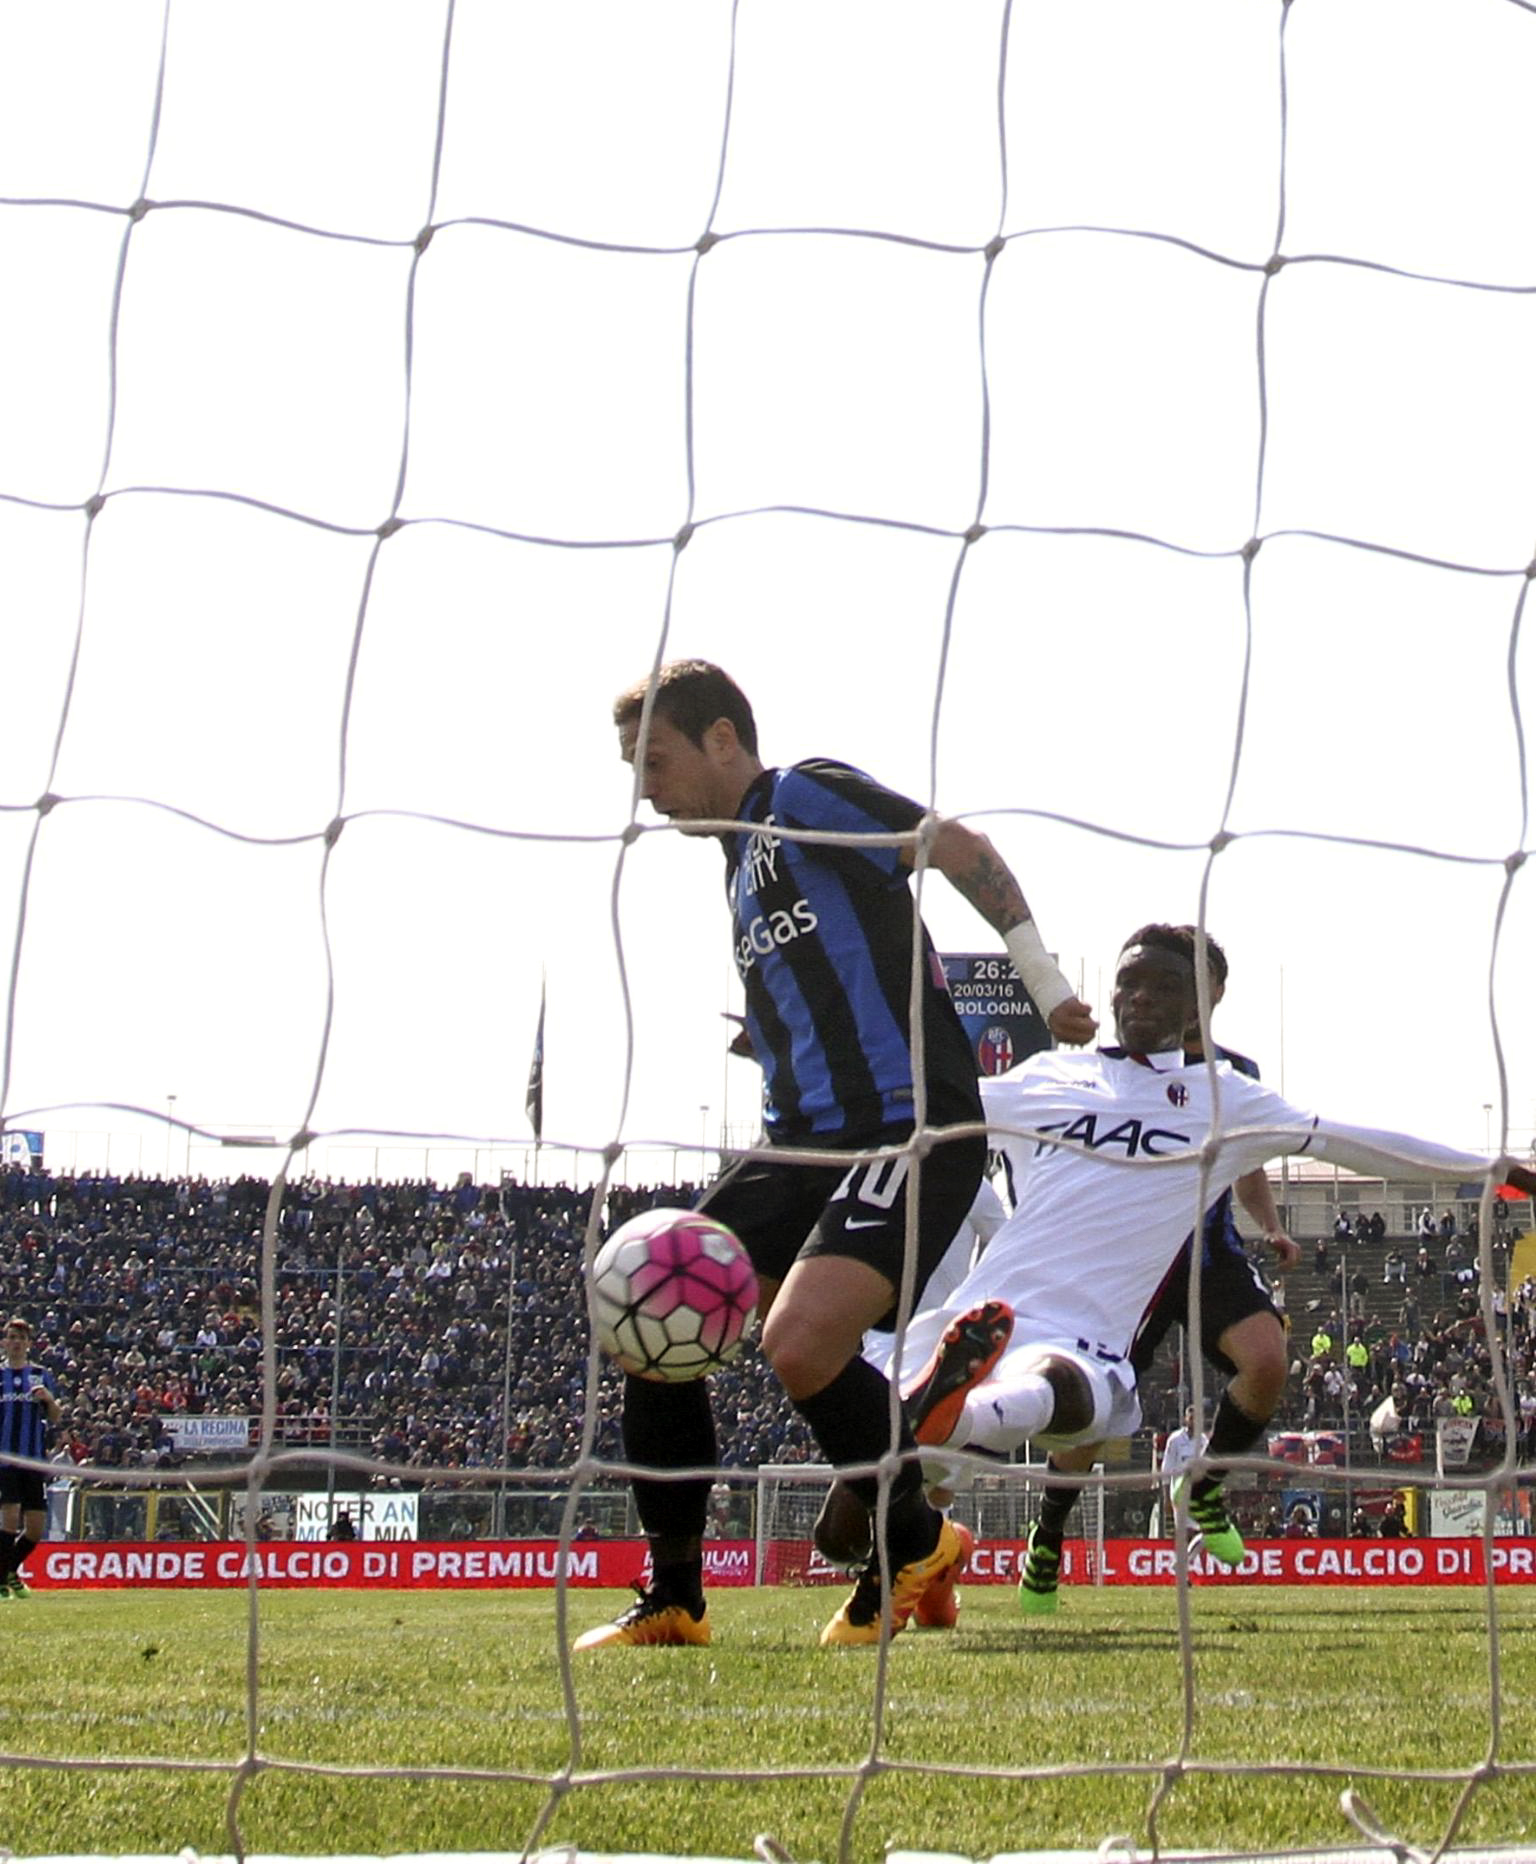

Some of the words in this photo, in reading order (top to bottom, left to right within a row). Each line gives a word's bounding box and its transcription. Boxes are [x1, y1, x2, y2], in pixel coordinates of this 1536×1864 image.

[974, 960, 1021, 980] 26:2
[954, 984, 1014, 997] 20/03/16
[954, 1001, 1033, 1016] BOLOGNA
[1034, 1114, 1191, 1158] FAAC
[382, 1500, 416, 1523] AN
[46, 1551, 206, 1579] GRANDE
[217, 1551, 350, 1579] CALCIO
[363, 1551, 398, 1578] DI
[412, 1551, 599, 1579] PREMIUM
[1294, 1548, 1424, 1576] CALCIO
[1436, 1549, 1471, 1576] DI
